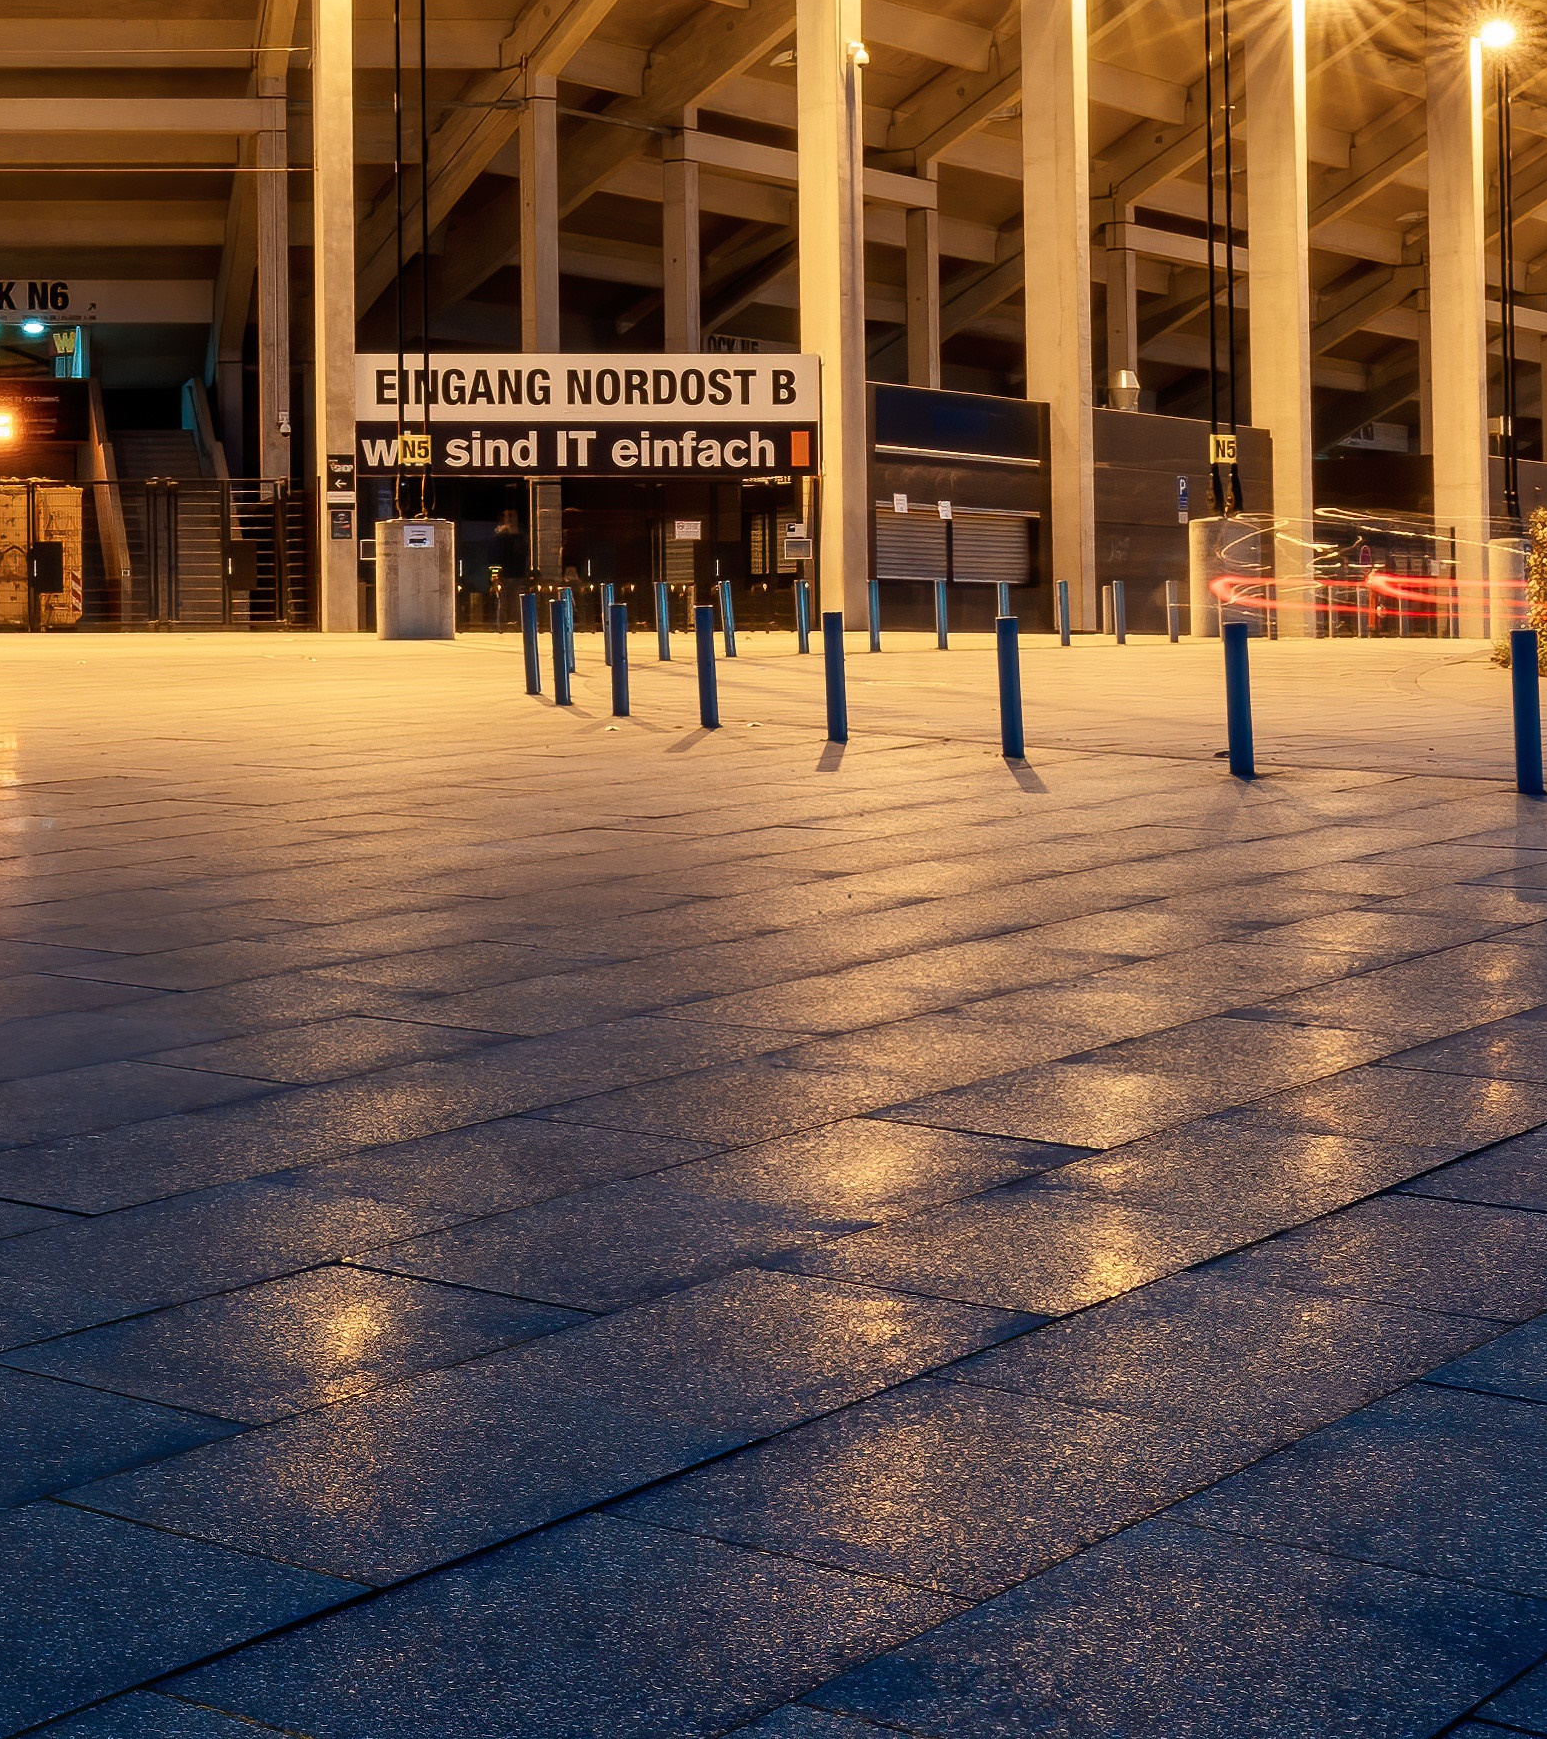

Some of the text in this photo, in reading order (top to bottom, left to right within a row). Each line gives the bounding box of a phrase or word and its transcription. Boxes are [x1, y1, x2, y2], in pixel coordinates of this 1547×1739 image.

[27, 281, 70, 310] N6
[375, 368, 797, 405] EINGANG NORDOST B
[402, 439, 430, 459] N5
[444, 430, 538, 467] sind
[556, 430, 597, 467] IT
[611, 430, 775, 468] einfach
[1215, 440, 1236, 458] N5
